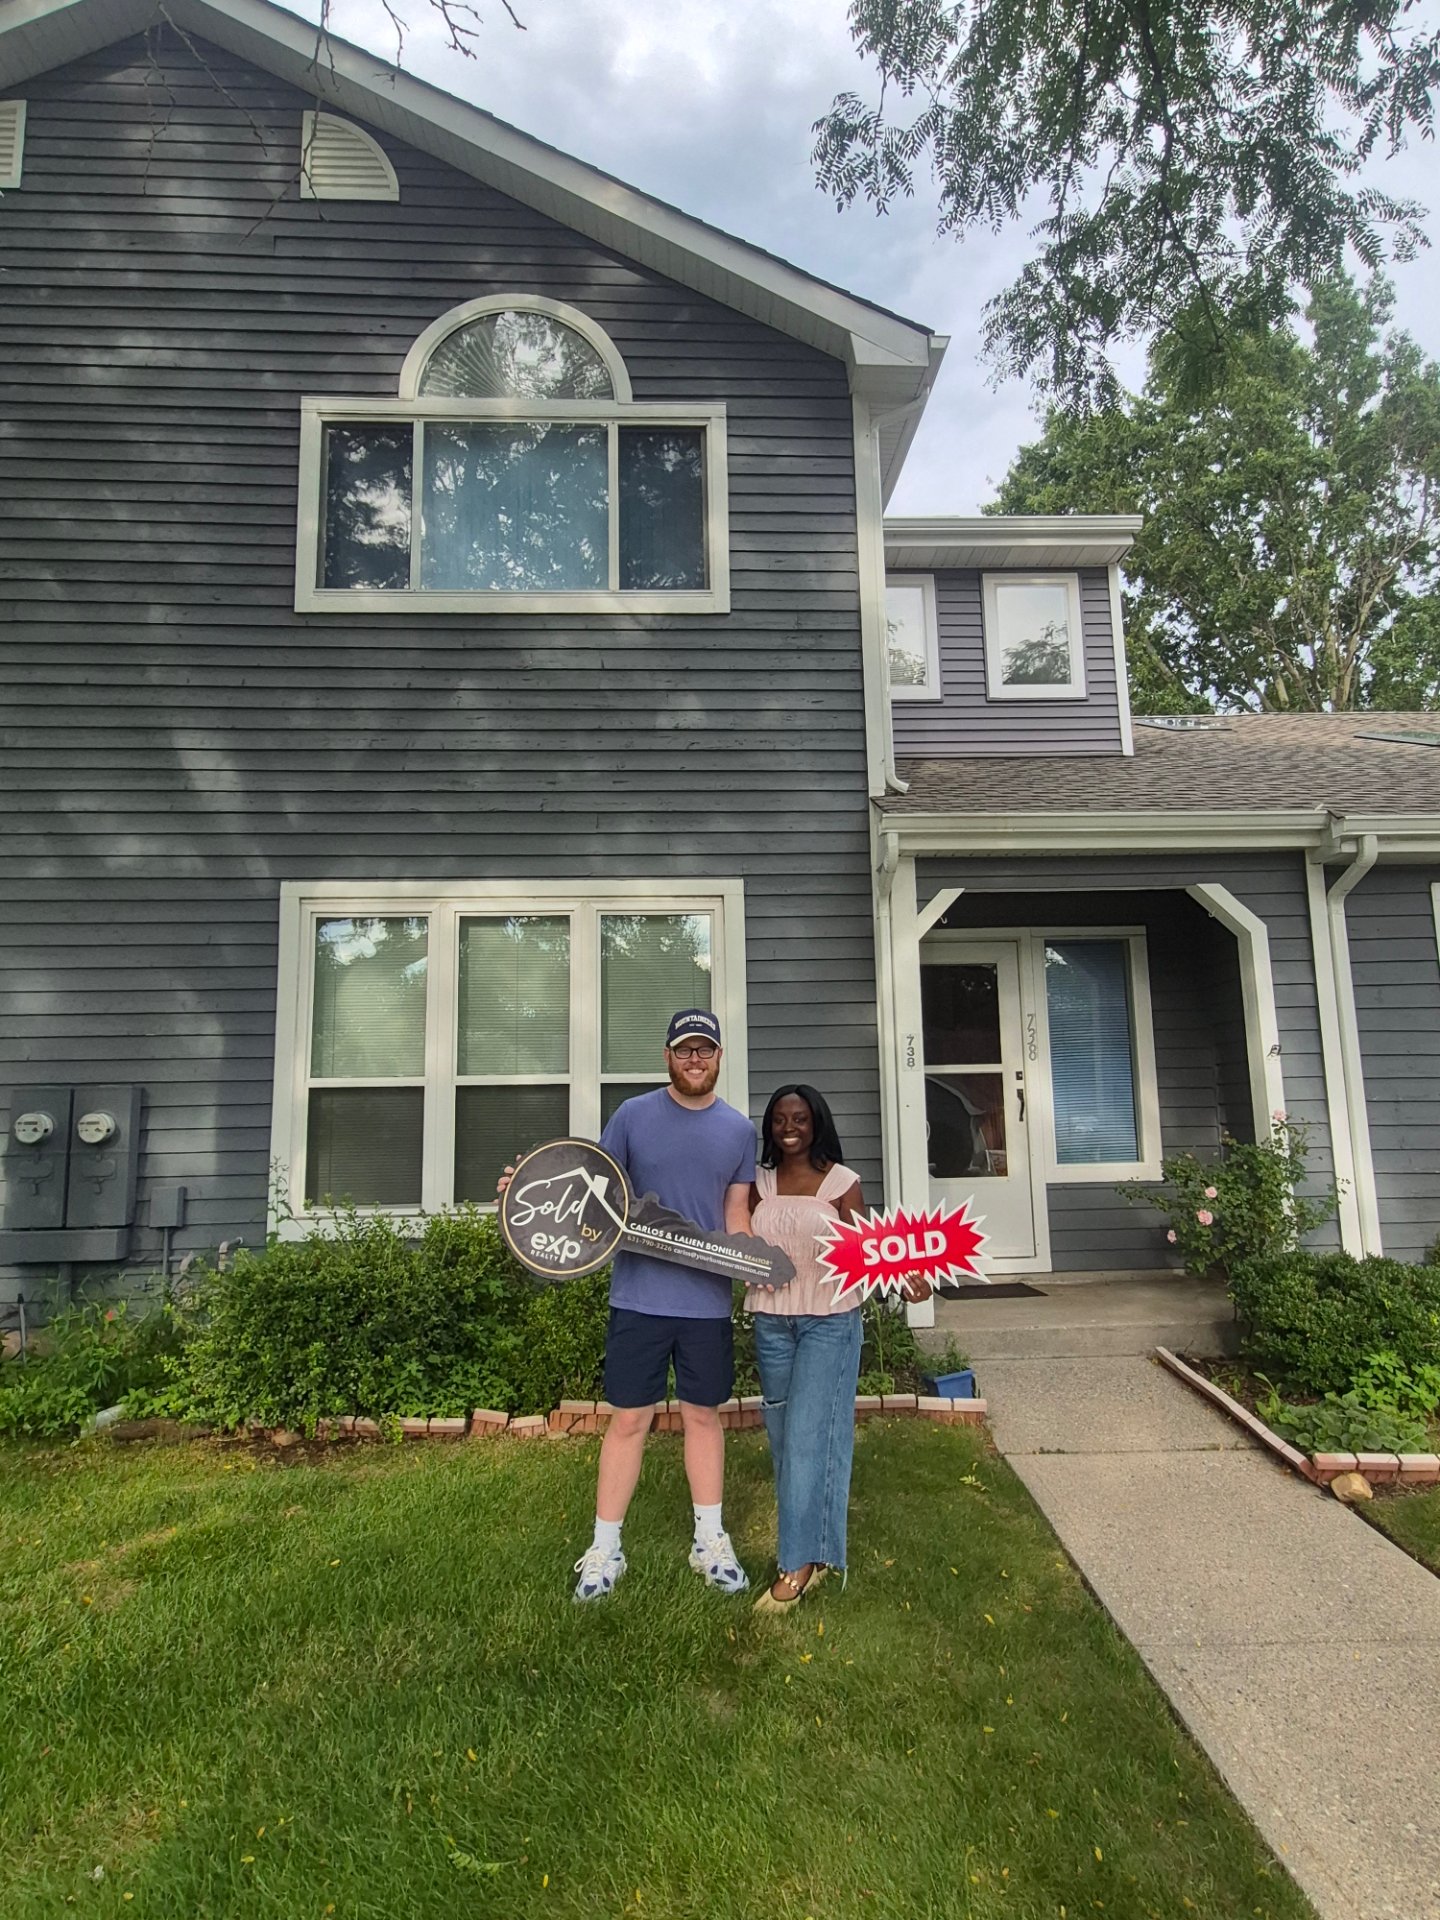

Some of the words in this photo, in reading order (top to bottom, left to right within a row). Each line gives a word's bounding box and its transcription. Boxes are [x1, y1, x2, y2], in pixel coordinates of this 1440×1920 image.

[906, 1036, 916, 1068] 738
[1027, 1013, 1037, 1061] 738
[510, 1178, 591, 1227] Sold
[581, 1223, 603, 1242] by
[630, 1222, 664, 1238] CARLOS
[665, 1232, 672, 1240] &
[674, 1234, 704, 1248] LALIEN
[705, 1242, 743, 1259] BONILLA
[861, 1230, 947, 1266] SOLD
[530, 1249, 558, 1262] REALTY
